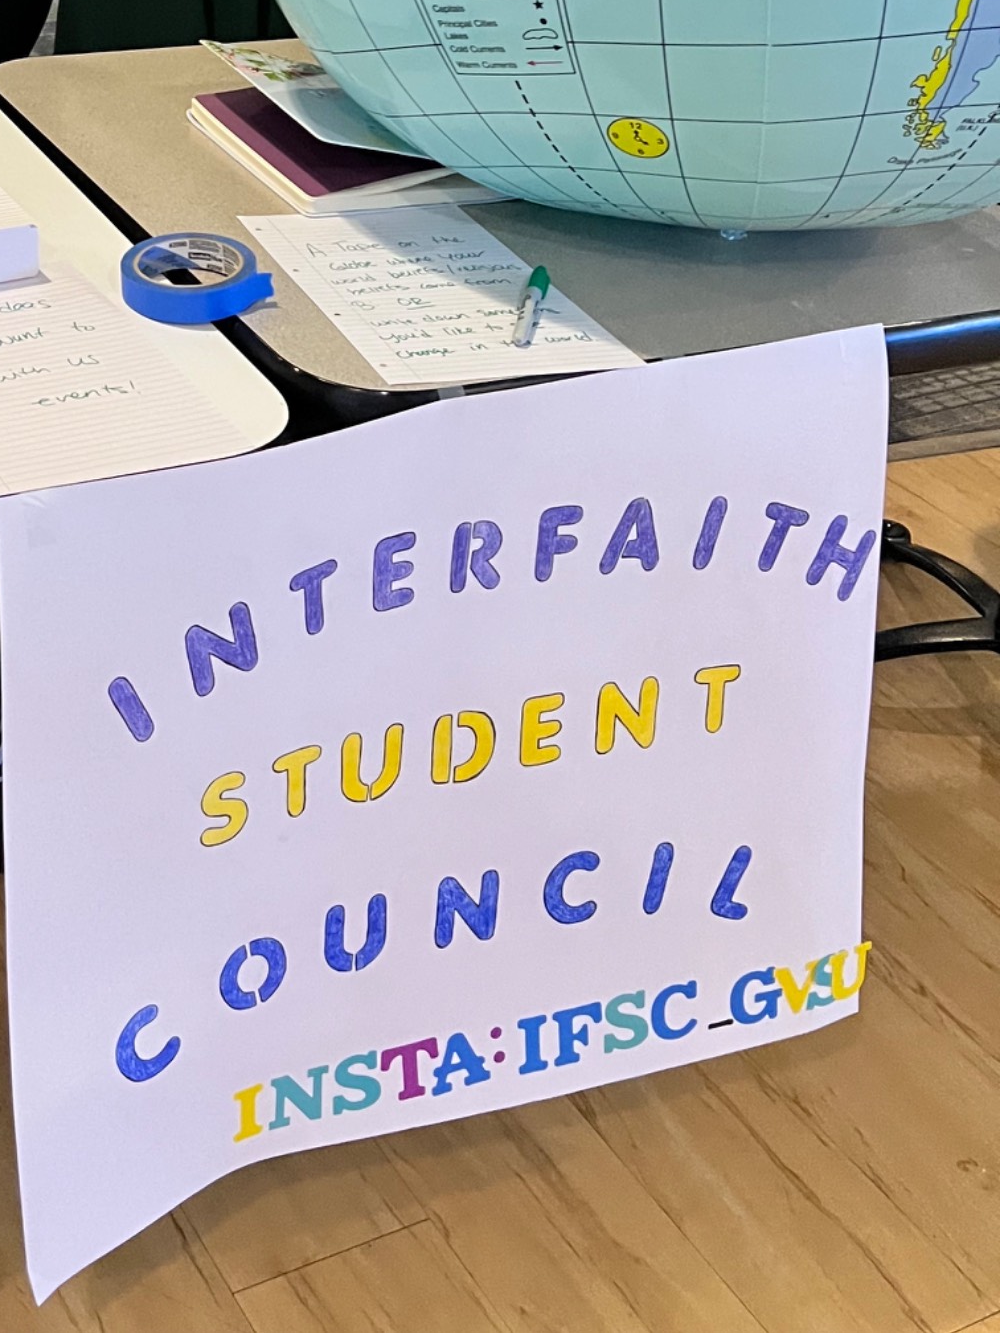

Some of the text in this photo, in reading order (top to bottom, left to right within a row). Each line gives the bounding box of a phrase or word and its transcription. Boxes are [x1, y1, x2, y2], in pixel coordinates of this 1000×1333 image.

[398, 239, 419, 248] on
[432, 235, 466, 245] the
[464, 277, 512, 287] from
[396, 297, 432, 307] OR
[422, 311, 470, 324] down
[72, 321, 96, 334] to
[470, 342, 489, 351] in
[67, 353, 100, 367] us
[33, 380, 141, 408] events!
[107, 495, 877, 743] INTERFAITH
[200, 663, 741, 848] STUDENT
[114, 842, 753, 1083] COUNCIL
